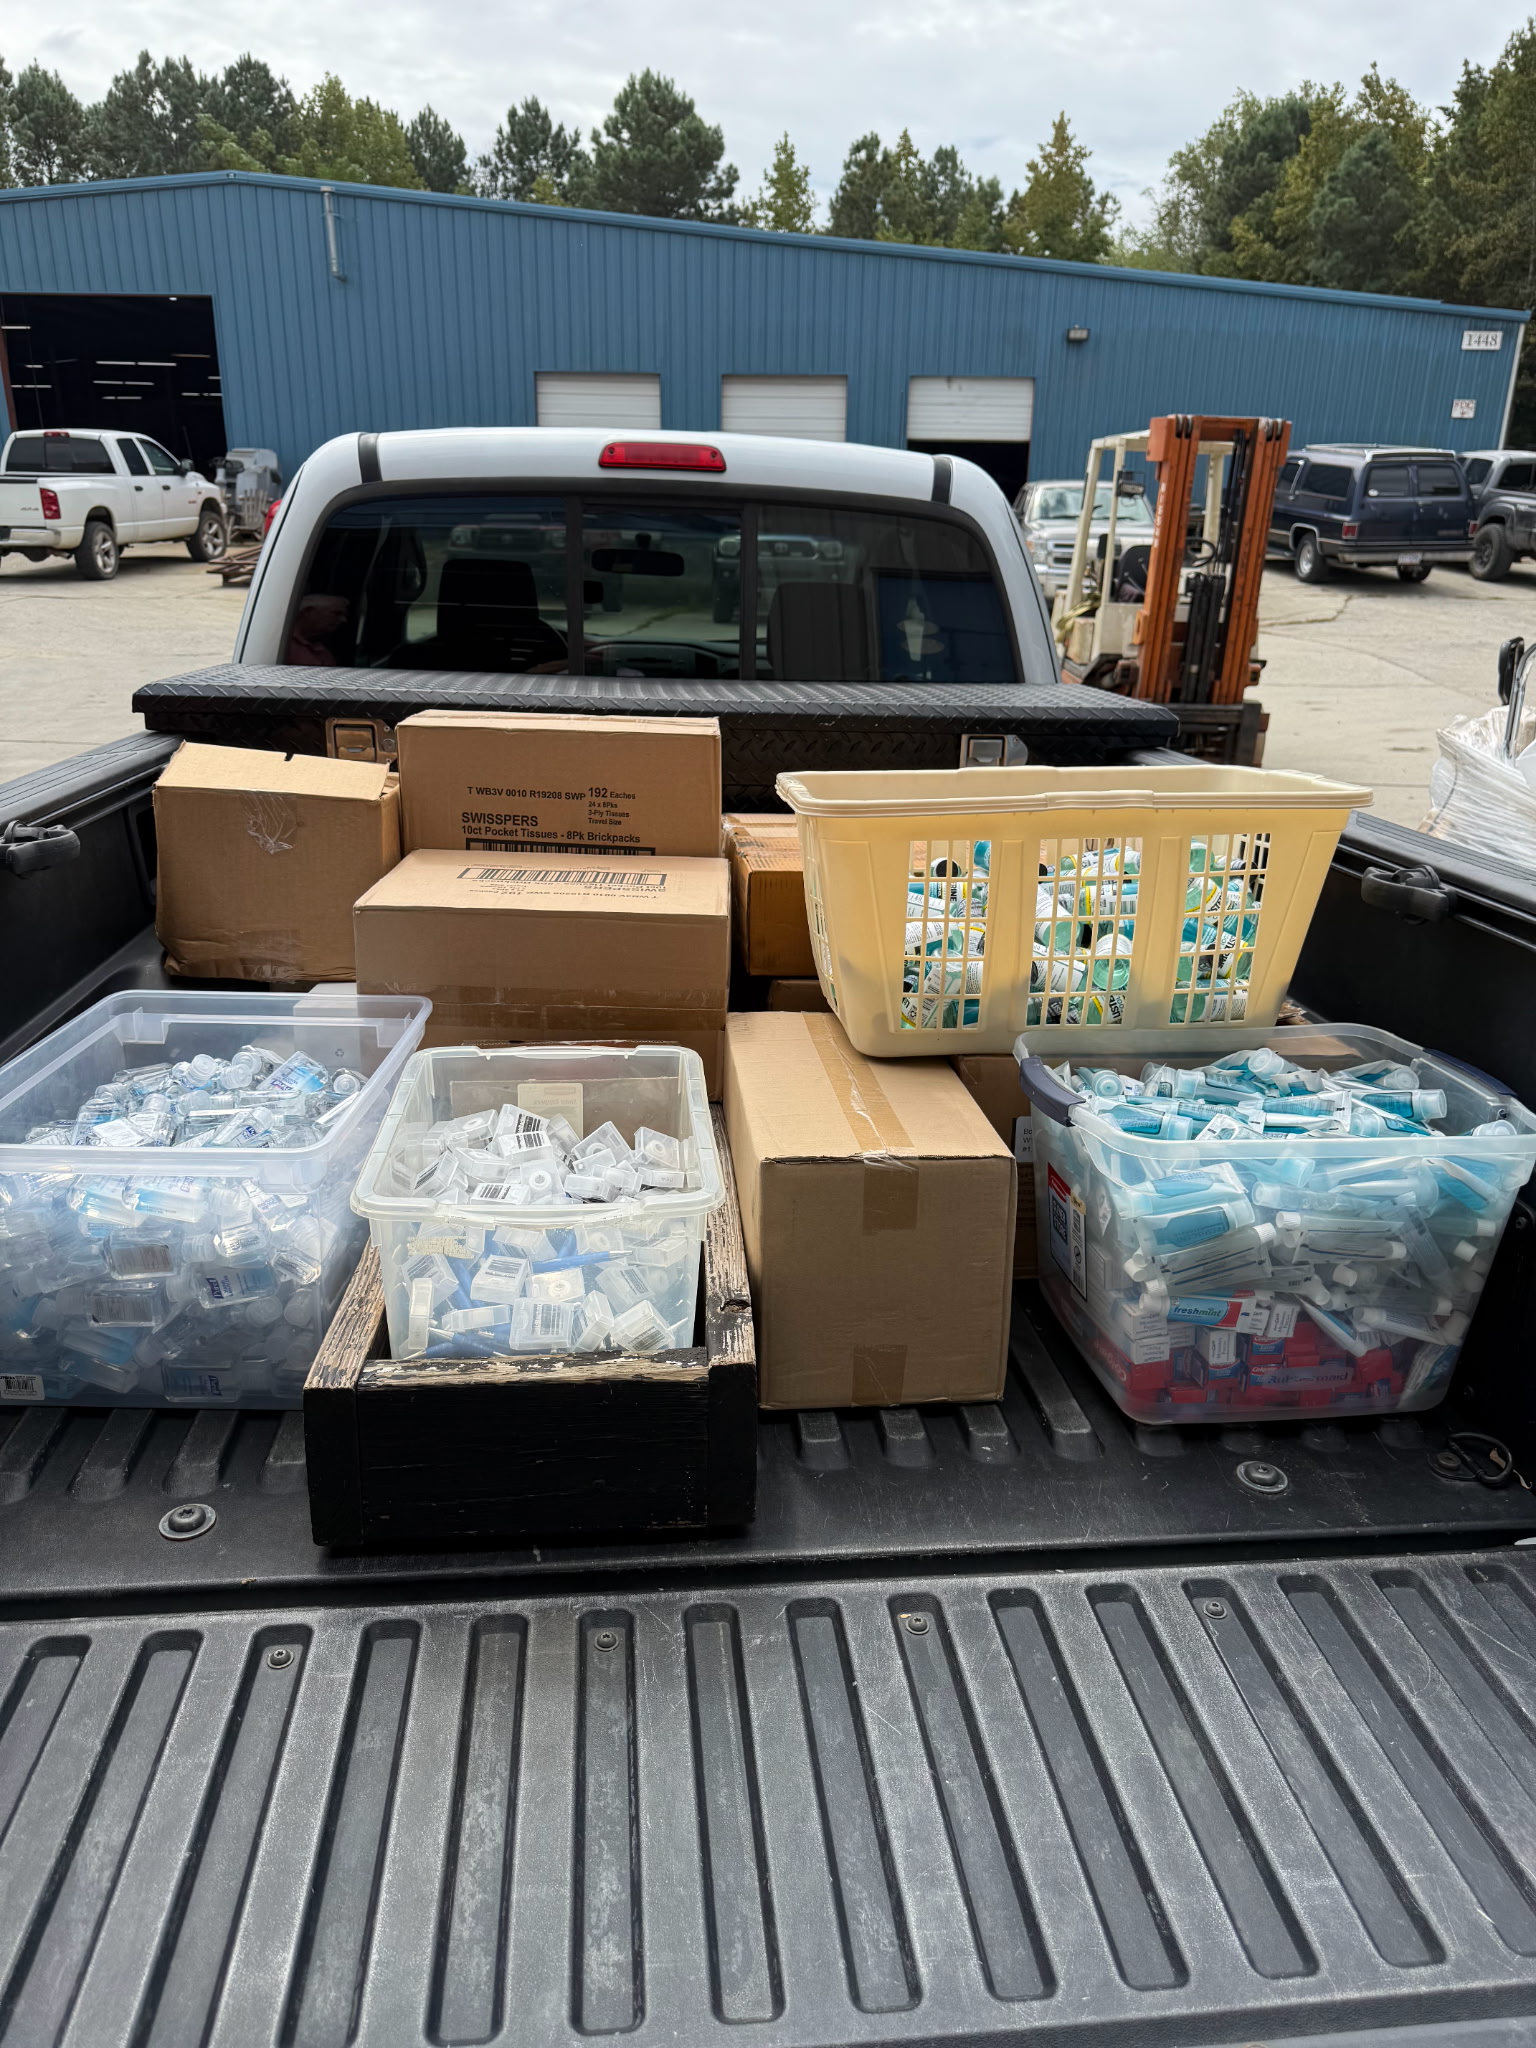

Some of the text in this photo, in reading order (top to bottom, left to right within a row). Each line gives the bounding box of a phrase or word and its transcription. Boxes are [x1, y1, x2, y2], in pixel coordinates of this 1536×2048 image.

[1466, 333, 1498, 346] 1448
[475, 787, 504, 796] WB3V
[505, 789, 527, 797] 0010
[529, 790, 562, 799] R19208
[564, 792, 586, 800] SWP
[588, 787, 636, 799] 192 Eaches
[461, 812, 539, 827] SWISSPERS
[605, 810, 630, 818] Tissues
[462, 825, 482, 835] 10ct
[484, 826, 518, 837] Pocket
[521, 828, 558, 839] Tissues
[566, 831, 584, 840] 8Pk
[587, 832, 641, 844] Brickpacks
[1174, 1306, 1222, 1317] freshmint
